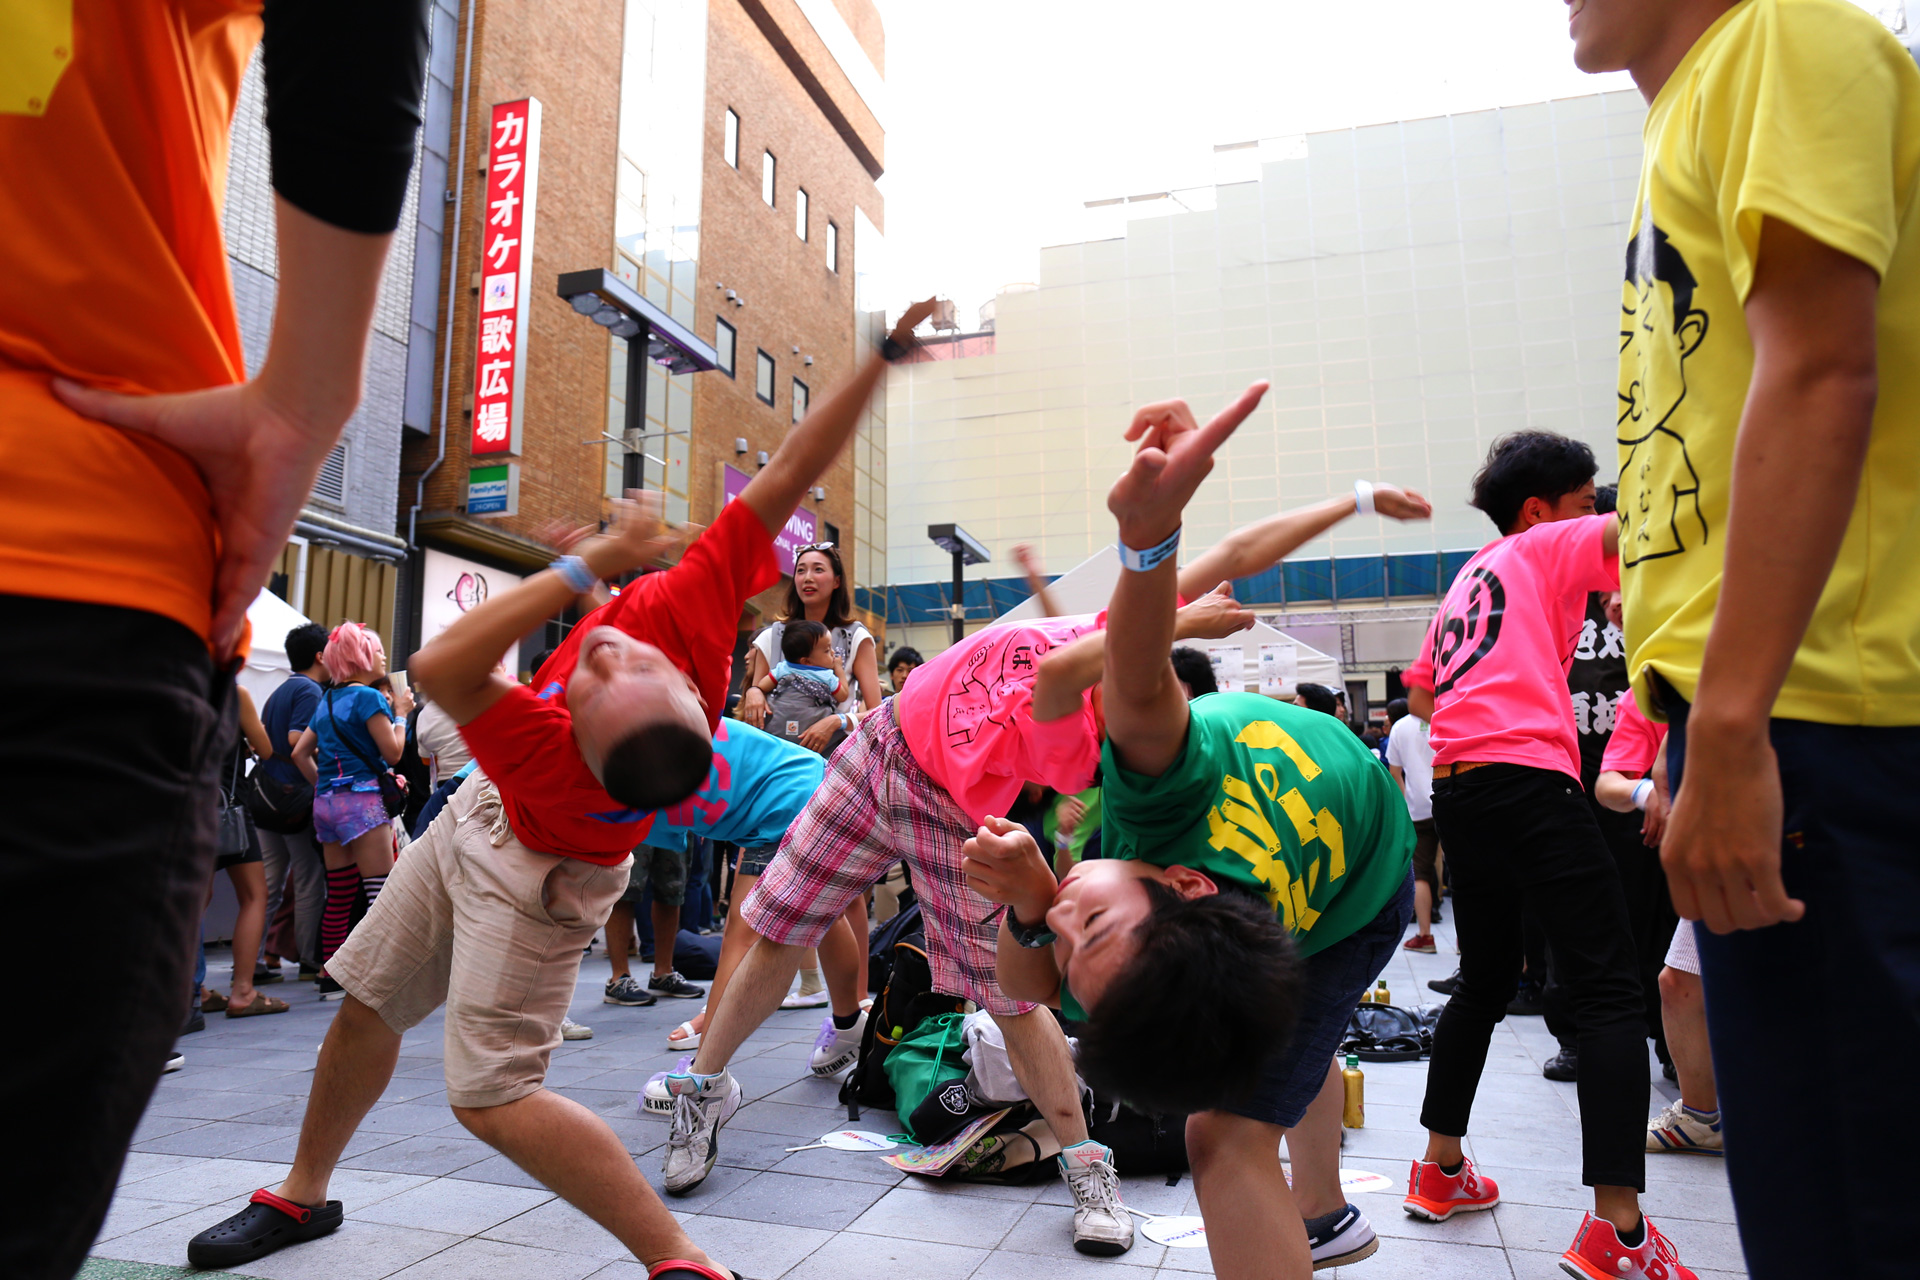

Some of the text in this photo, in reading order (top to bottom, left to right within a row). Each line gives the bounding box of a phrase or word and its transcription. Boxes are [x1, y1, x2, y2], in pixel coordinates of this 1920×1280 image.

[476, 112, 525, 443] カラオケ 歌広場
[470, 484, 506, 494] FamilyMart
